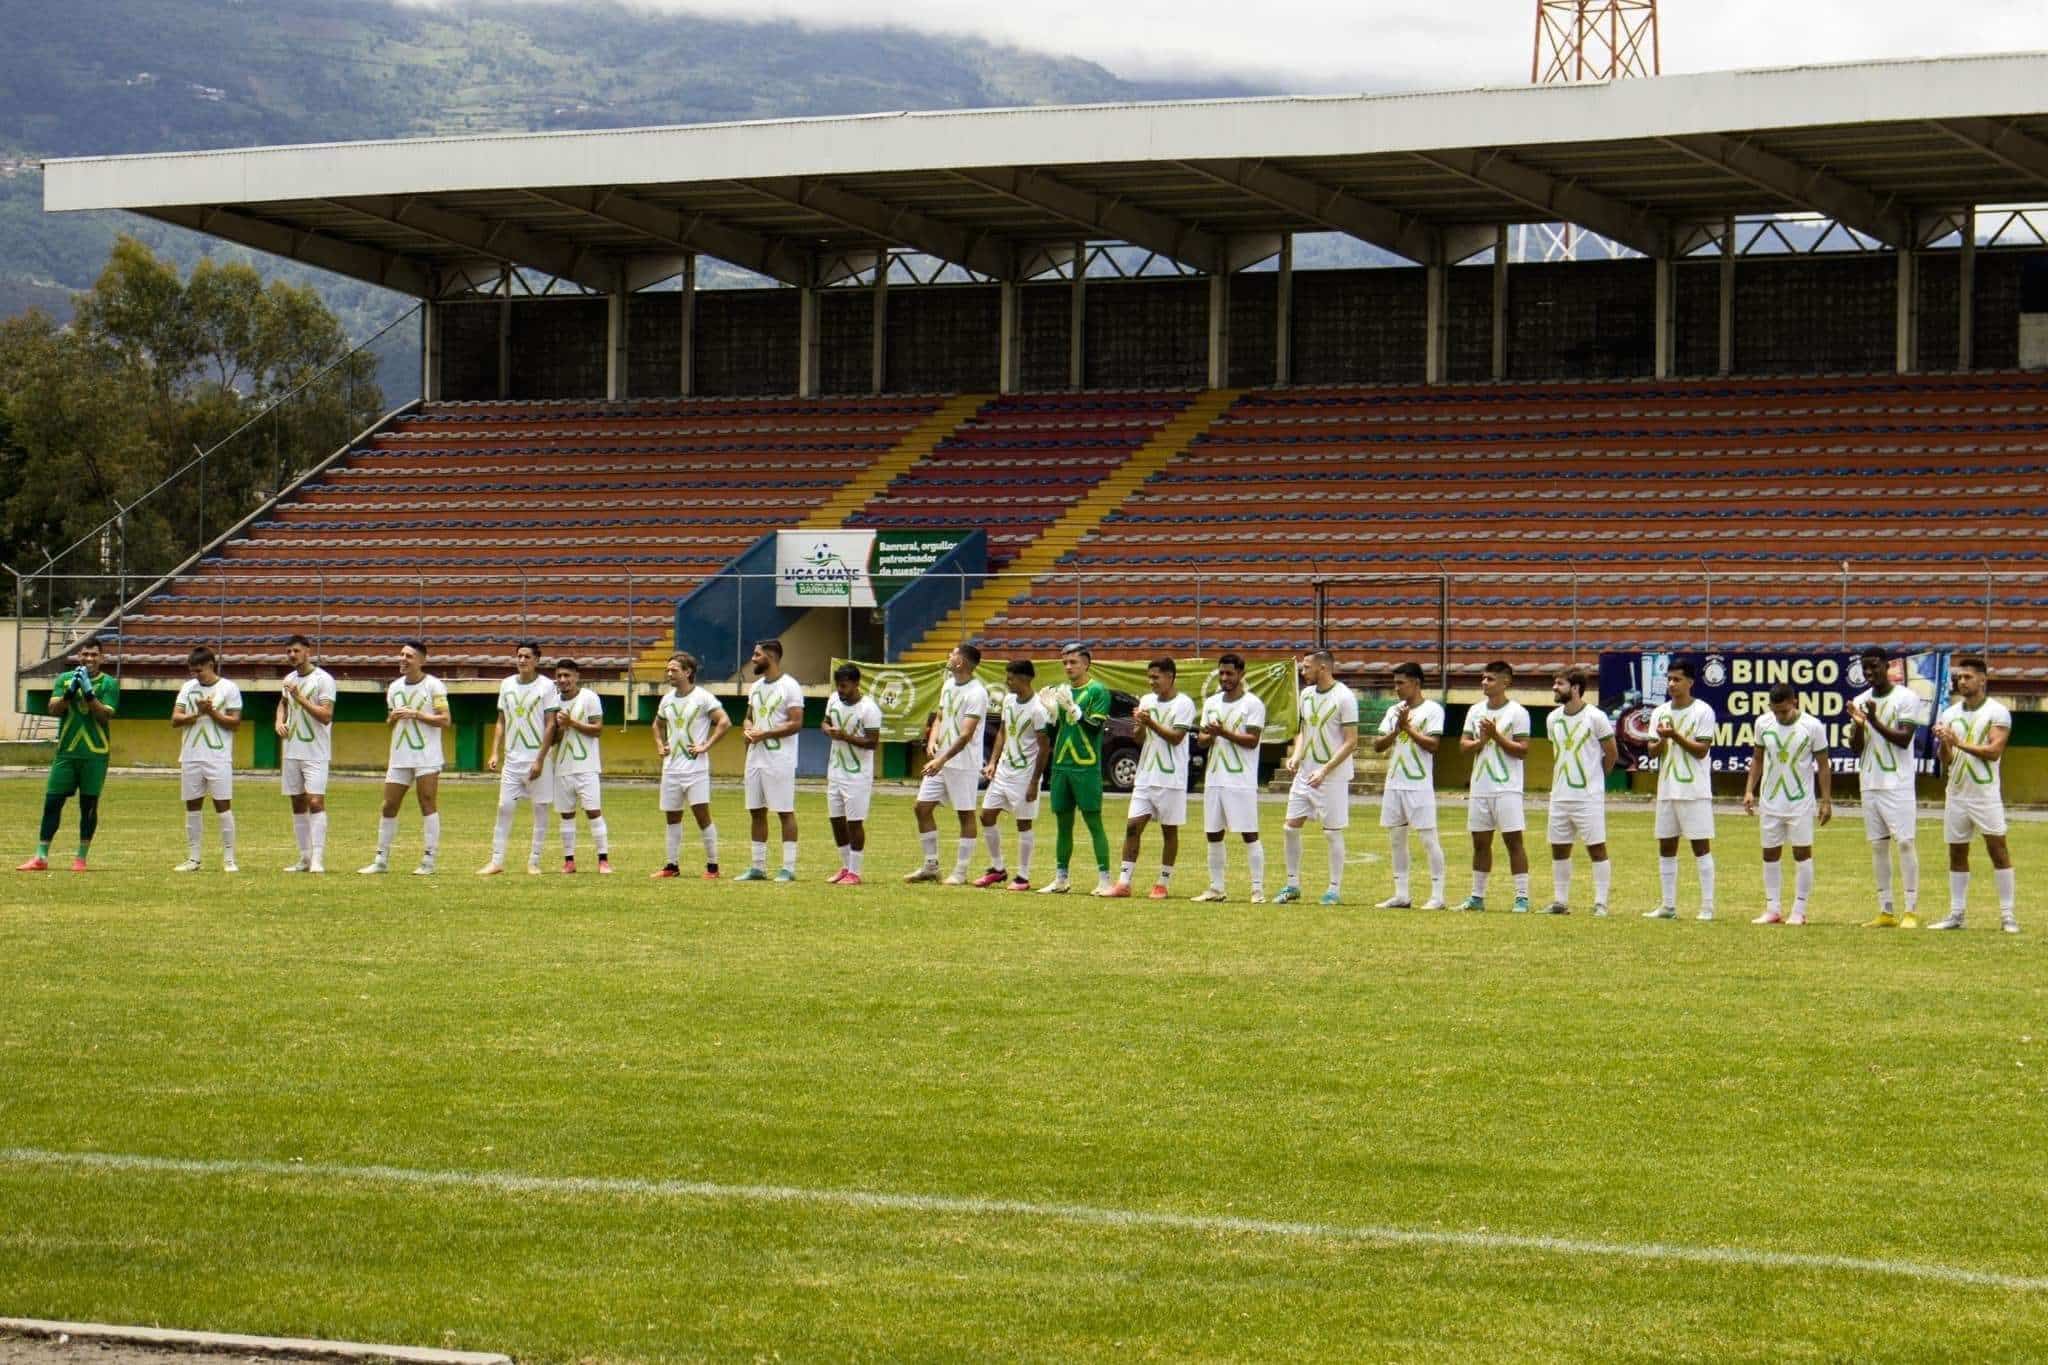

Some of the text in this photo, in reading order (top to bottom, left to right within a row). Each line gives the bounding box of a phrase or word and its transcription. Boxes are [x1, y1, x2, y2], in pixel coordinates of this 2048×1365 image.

[785, 568, 813, 580] LIGA
[798, 583, 846, 594] BANRURAL
[1732, 659, 1839, 684] BINGO
[1727, 691, 1843, 716] GRND
